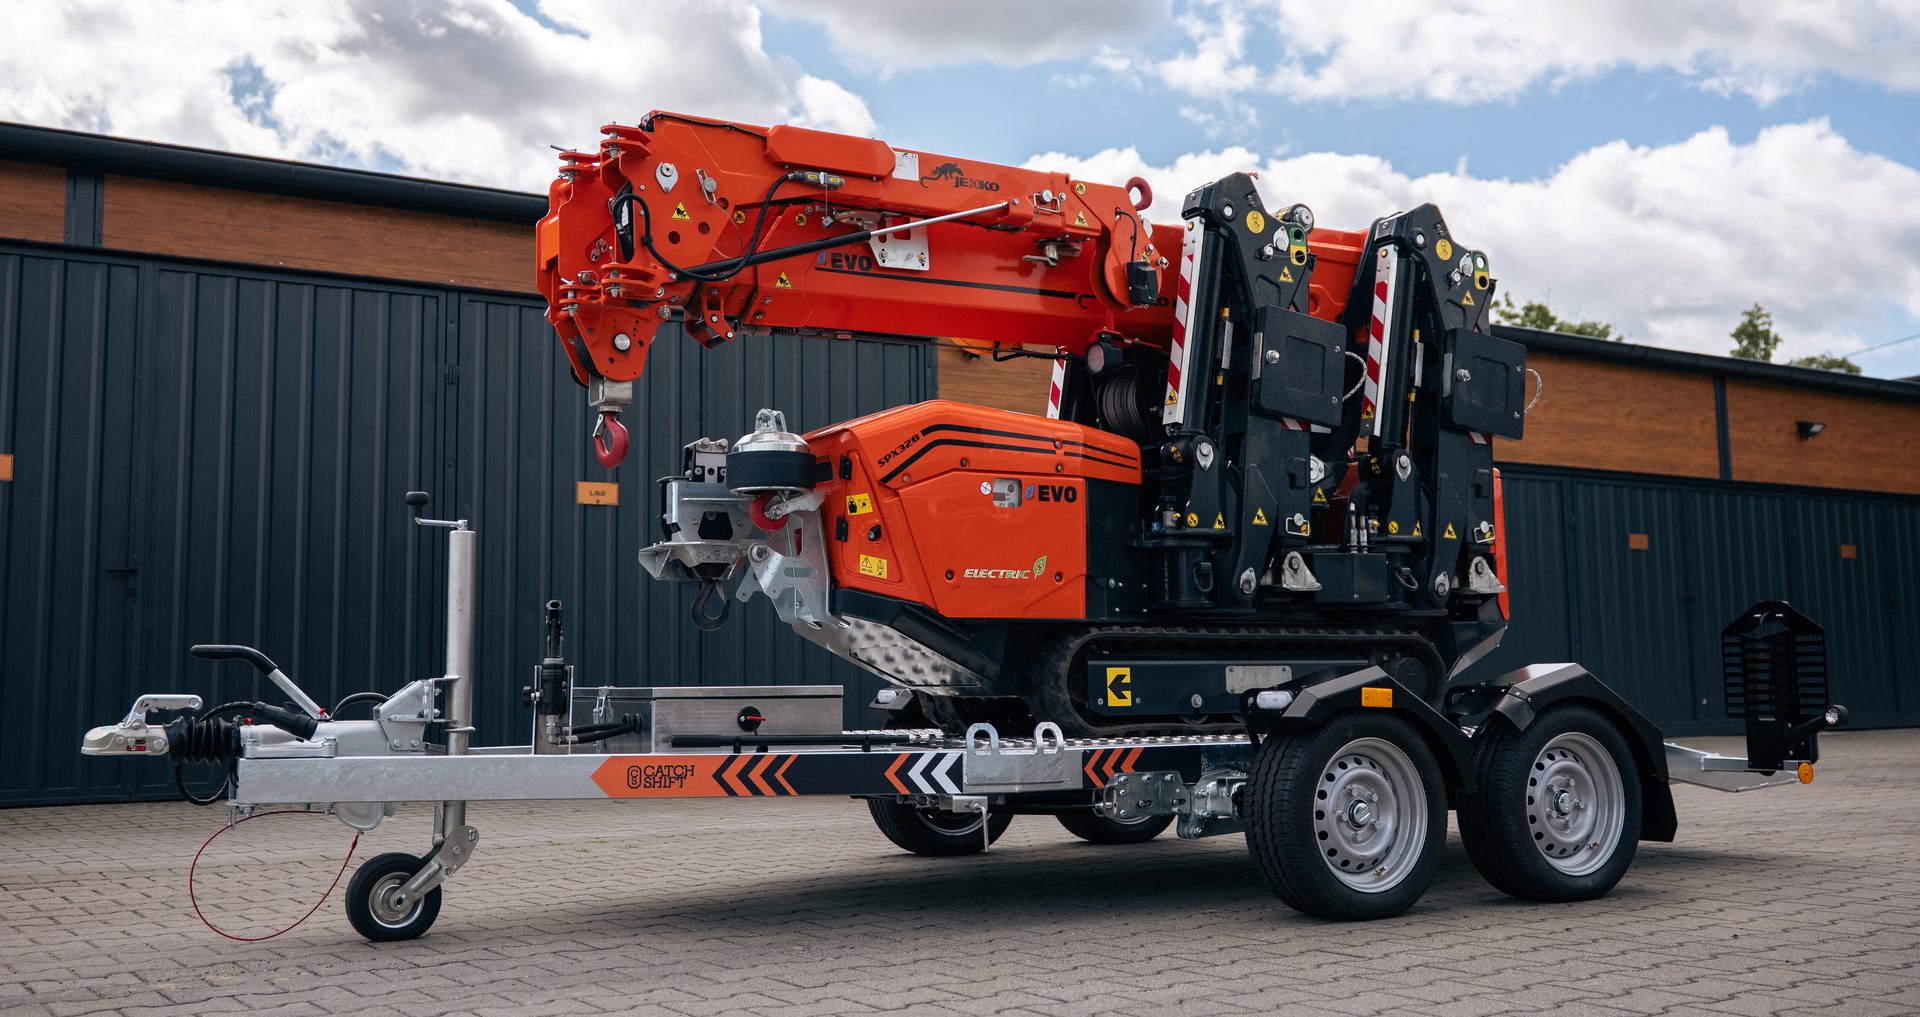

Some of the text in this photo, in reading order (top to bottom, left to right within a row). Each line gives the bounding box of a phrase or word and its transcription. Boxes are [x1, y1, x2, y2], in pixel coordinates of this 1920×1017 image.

[831, 252, 872, 271] EVO
[877, 434, 920, 468] SPX328
[1038, 484, 1077, 503] EVO
[963, 568, 1030, 579] ELECTRIC
[643, 765, 695, 777] CATCH
[643, 776, 687, 788] SHIFT
